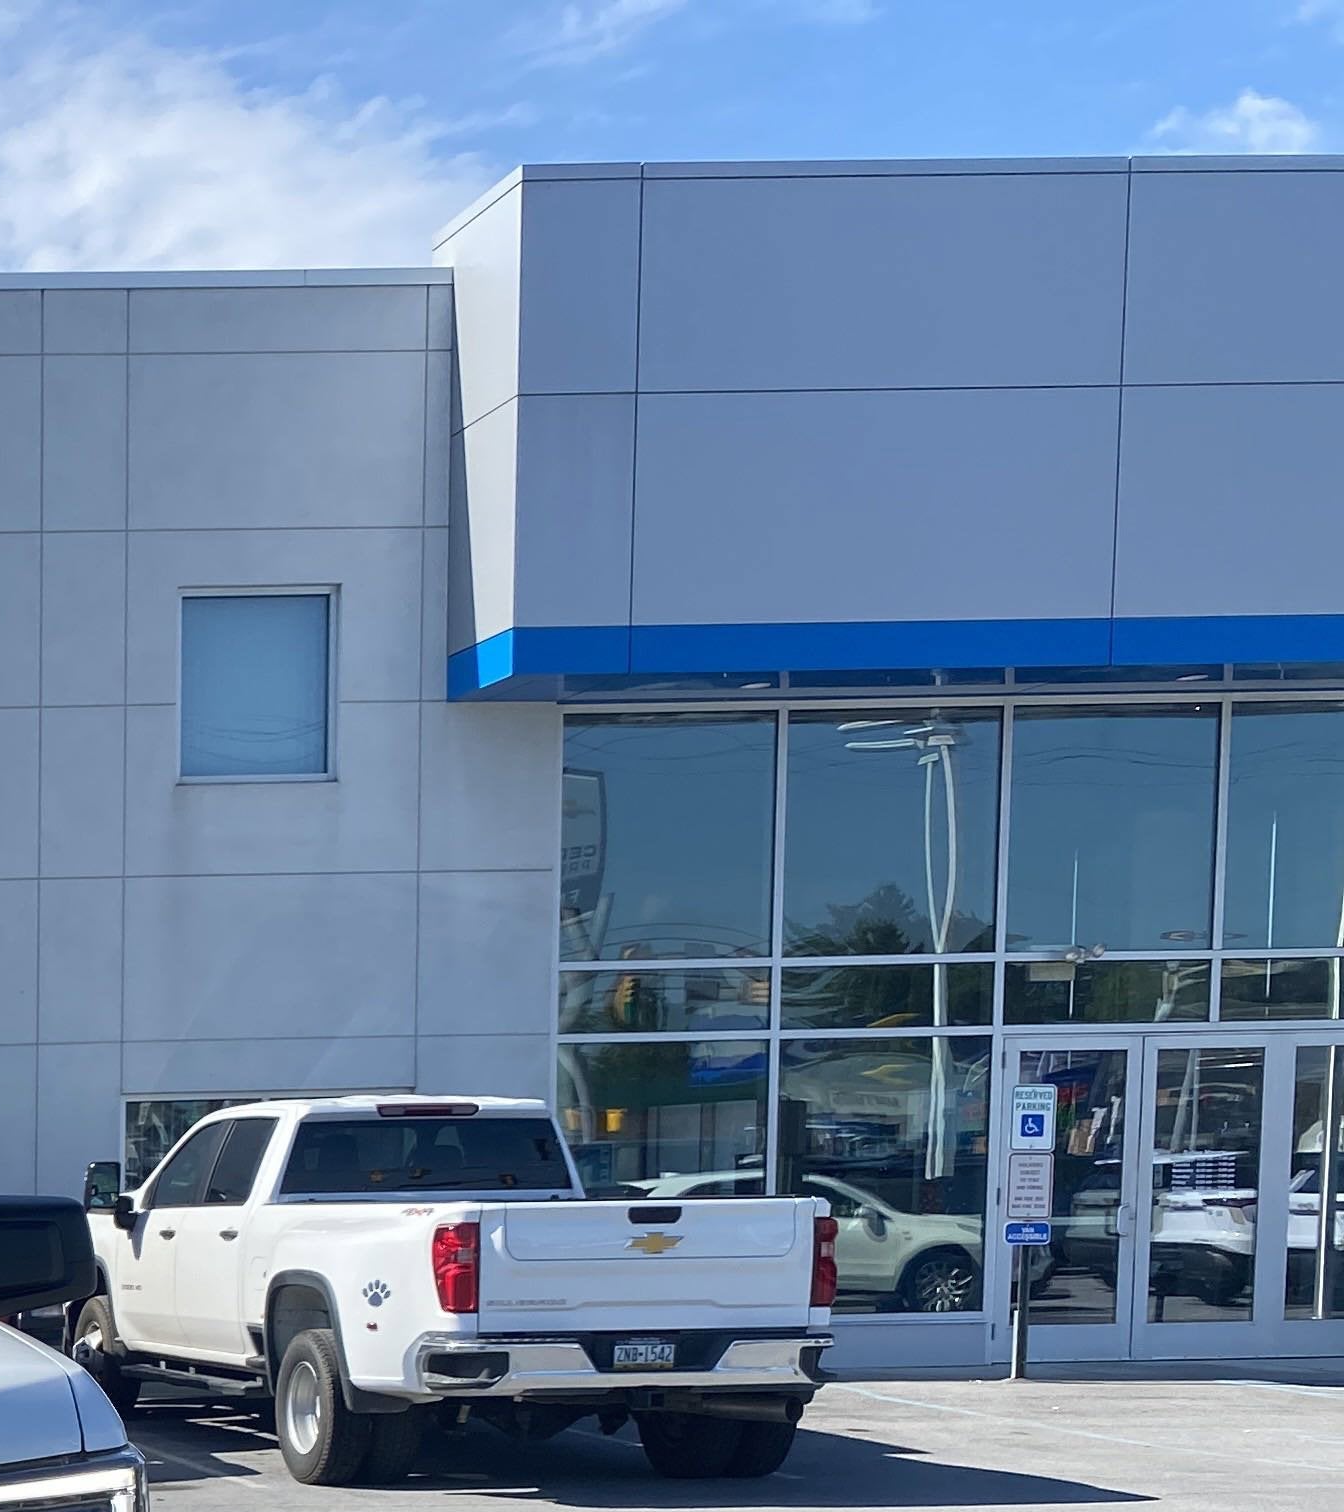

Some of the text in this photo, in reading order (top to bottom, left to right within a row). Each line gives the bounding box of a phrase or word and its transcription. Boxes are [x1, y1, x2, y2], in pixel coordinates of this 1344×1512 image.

[1015, 1090, 1053, 1100] RESERVED
[1015, 1102, 1052, 1111] PARKING
[616, 1346, 673, 1362] ZNB-1542
